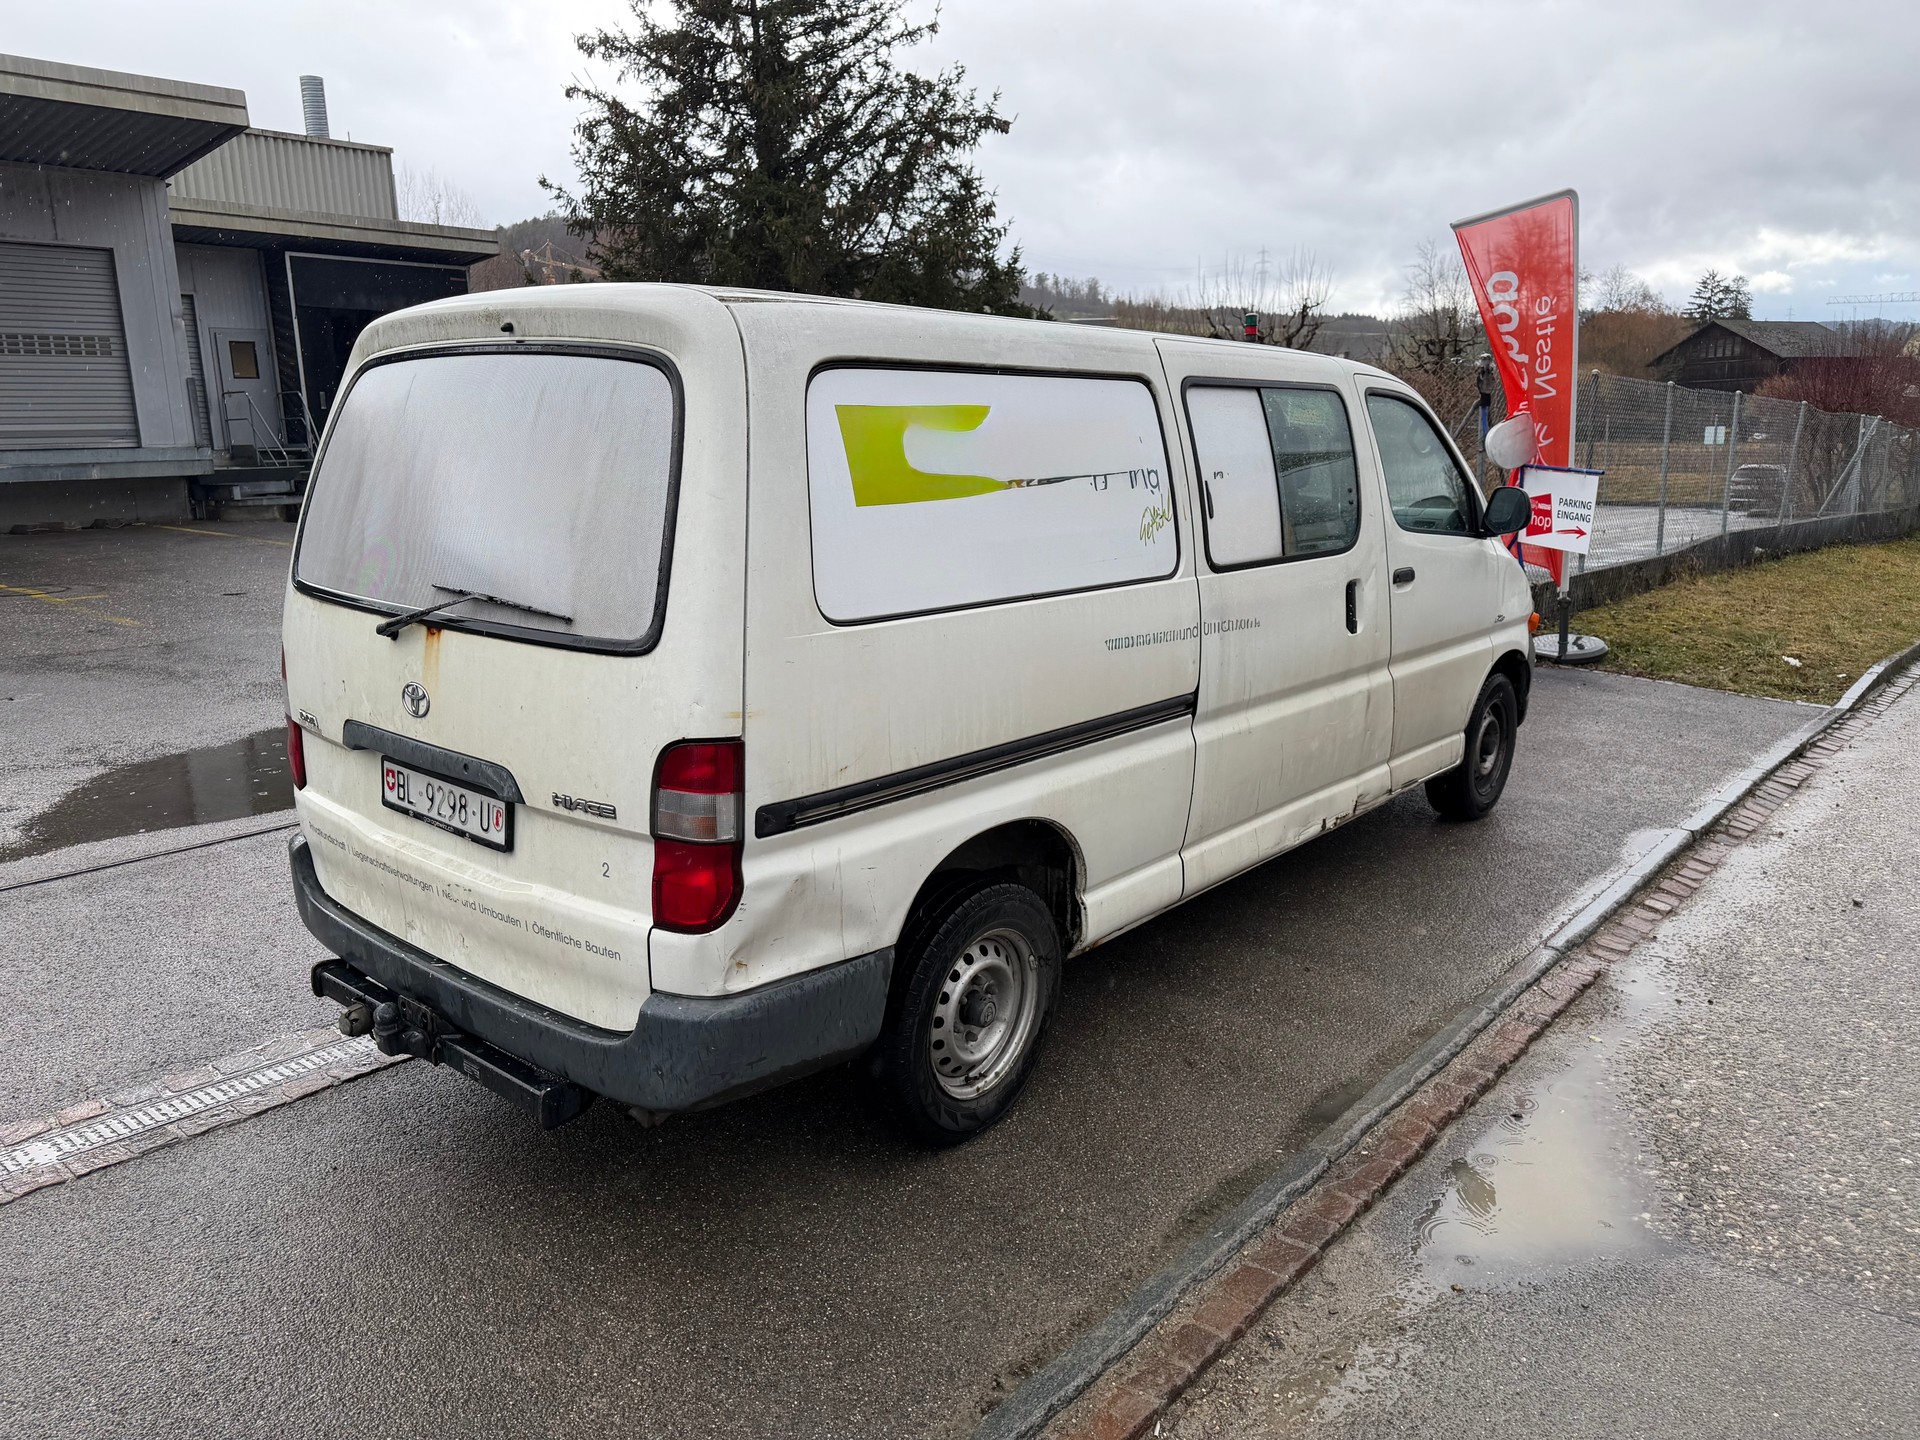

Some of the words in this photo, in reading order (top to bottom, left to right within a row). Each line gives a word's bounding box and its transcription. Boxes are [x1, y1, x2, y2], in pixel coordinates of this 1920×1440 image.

[1558, 497, 1593, 511] PARKING
[1530, 511, 1552, 530] hop
[1556, 510, 1592, 523] EINGANG
[552, 792, 617, 820] HIACE
[602, 862, 610, 878] 2
[478, 902, 522, 928] Umbauten
[532, 920, 582, 949] Öffentliche
[585, 940, 621, 961] Bauten
